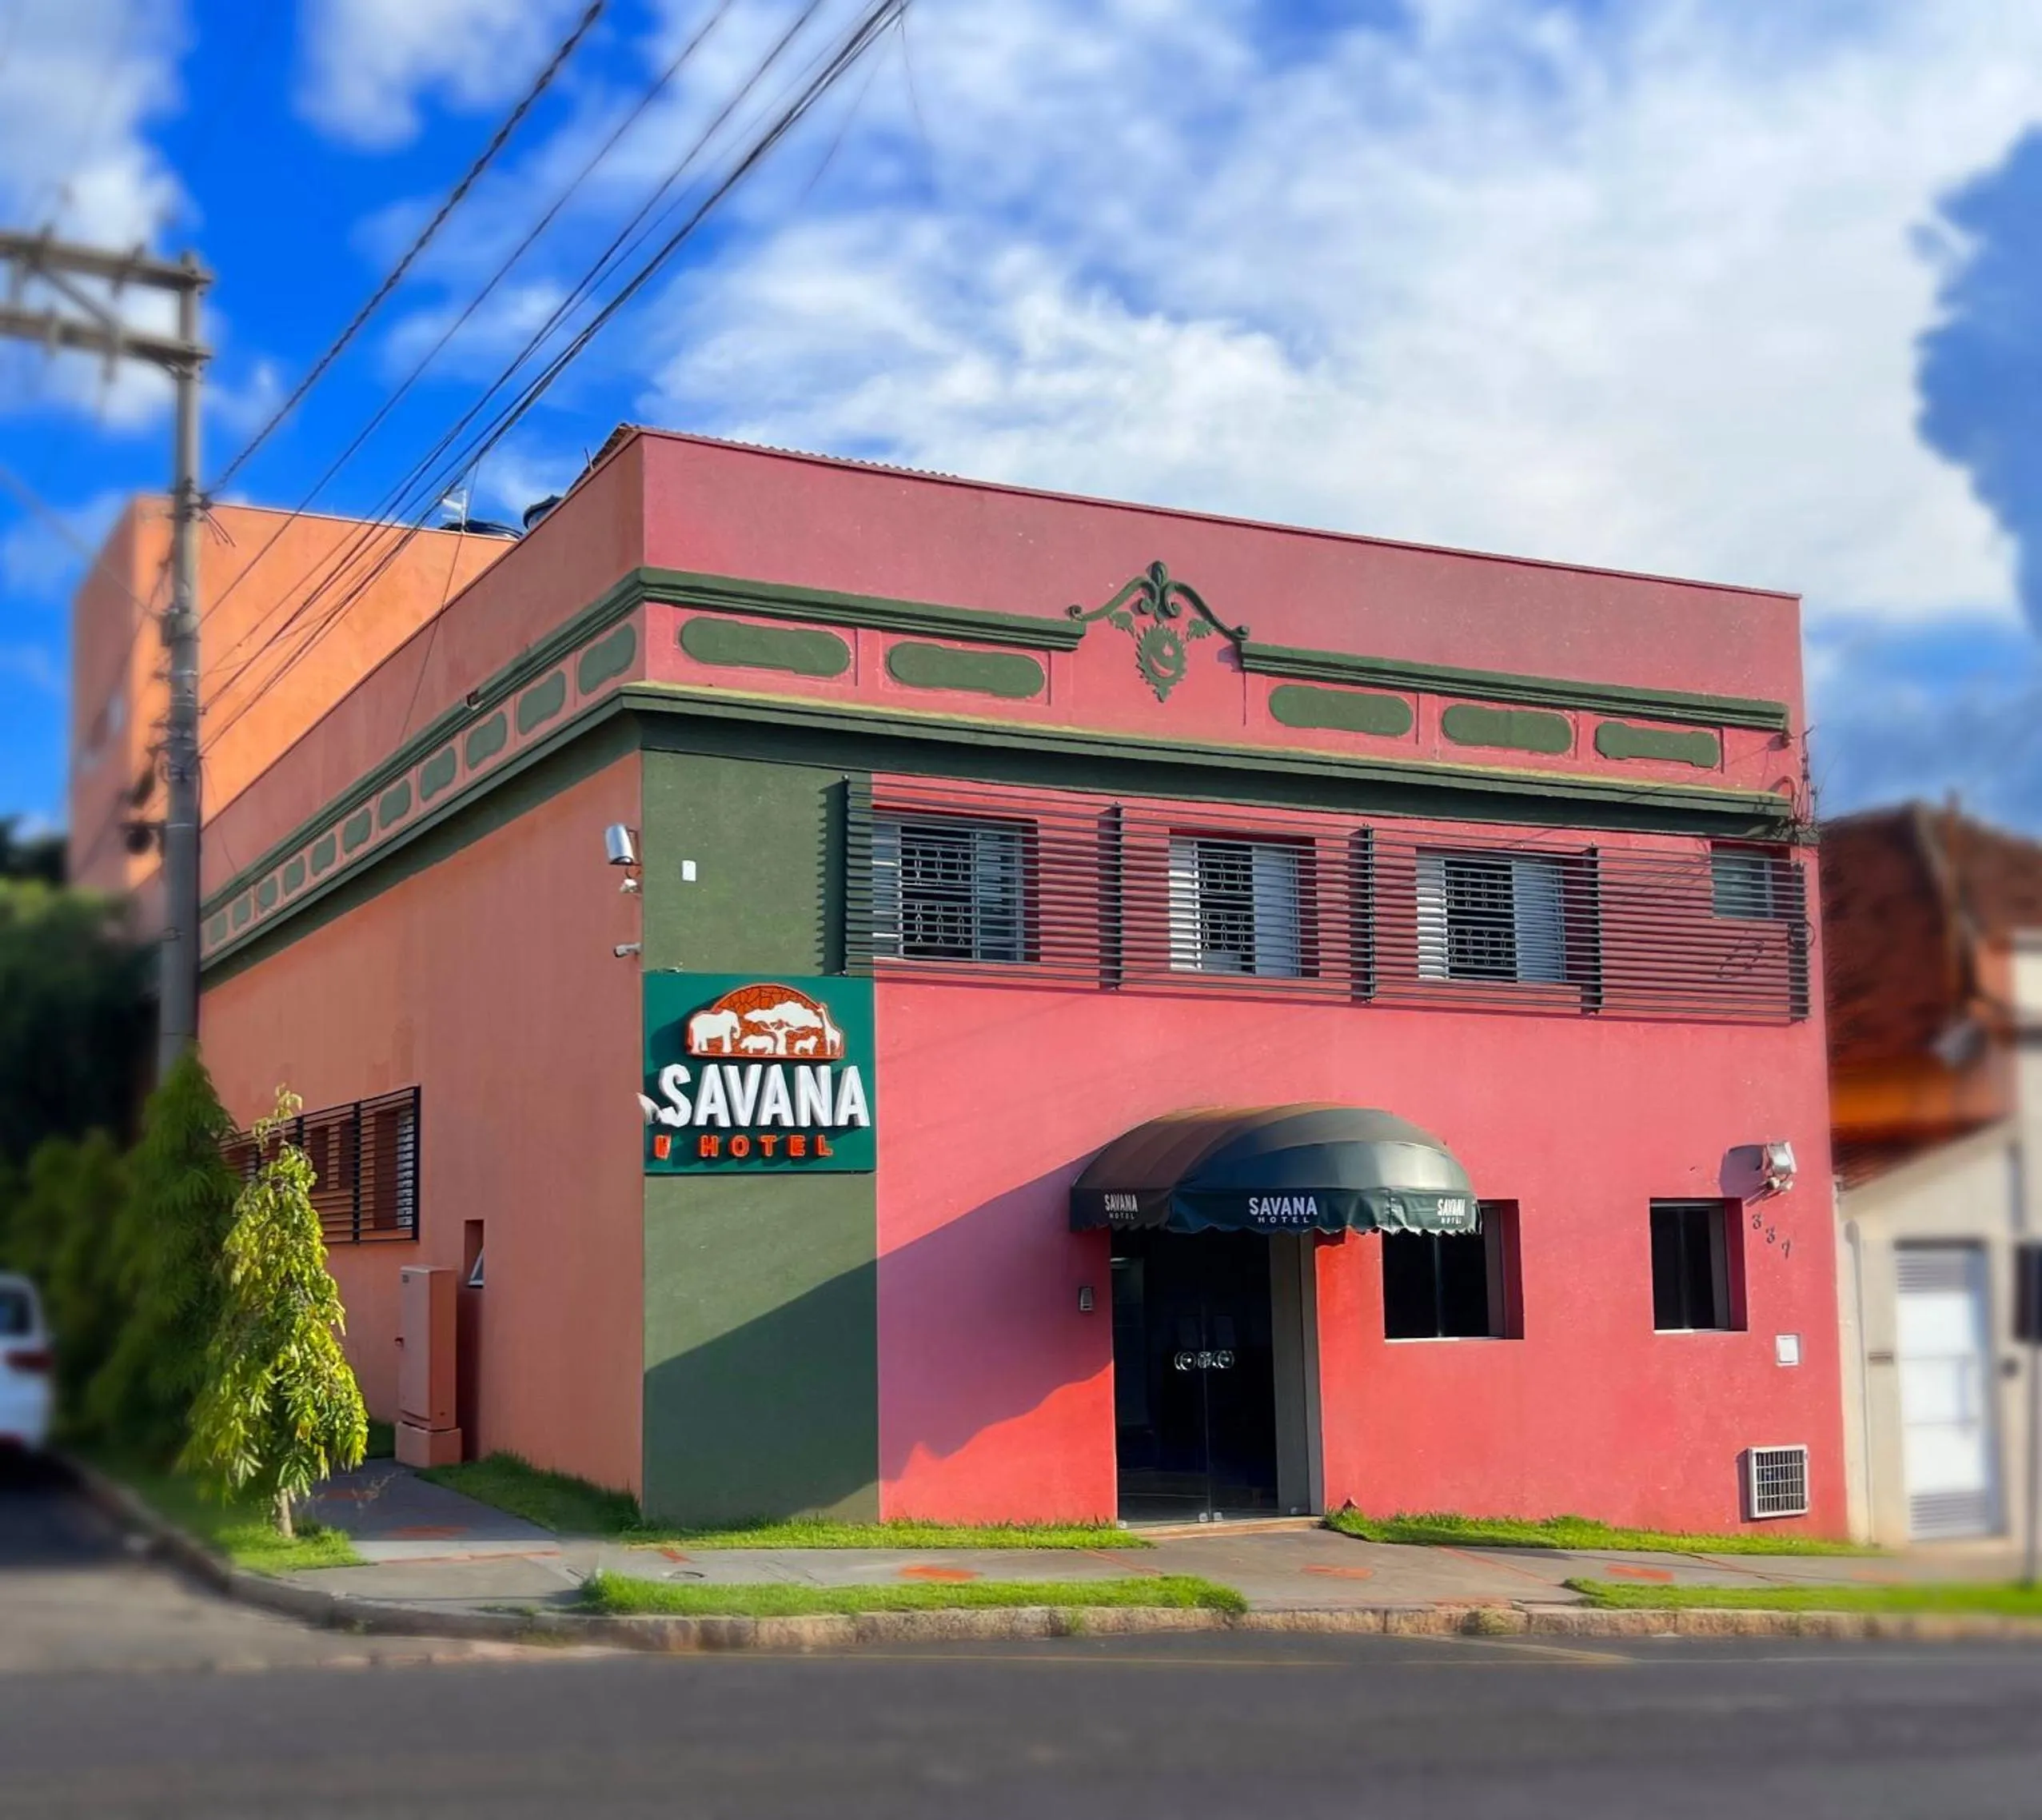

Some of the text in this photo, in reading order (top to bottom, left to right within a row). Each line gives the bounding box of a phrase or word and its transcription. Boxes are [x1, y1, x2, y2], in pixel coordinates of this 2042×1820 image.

[657, 1064, 871, 1128] SAVANA
[700, 1135, 833, 1158] HOTEL
[1104, 1193, 1139, 1212] SAVANA
[1249, 1196, 1318, 1215] SAVANA
